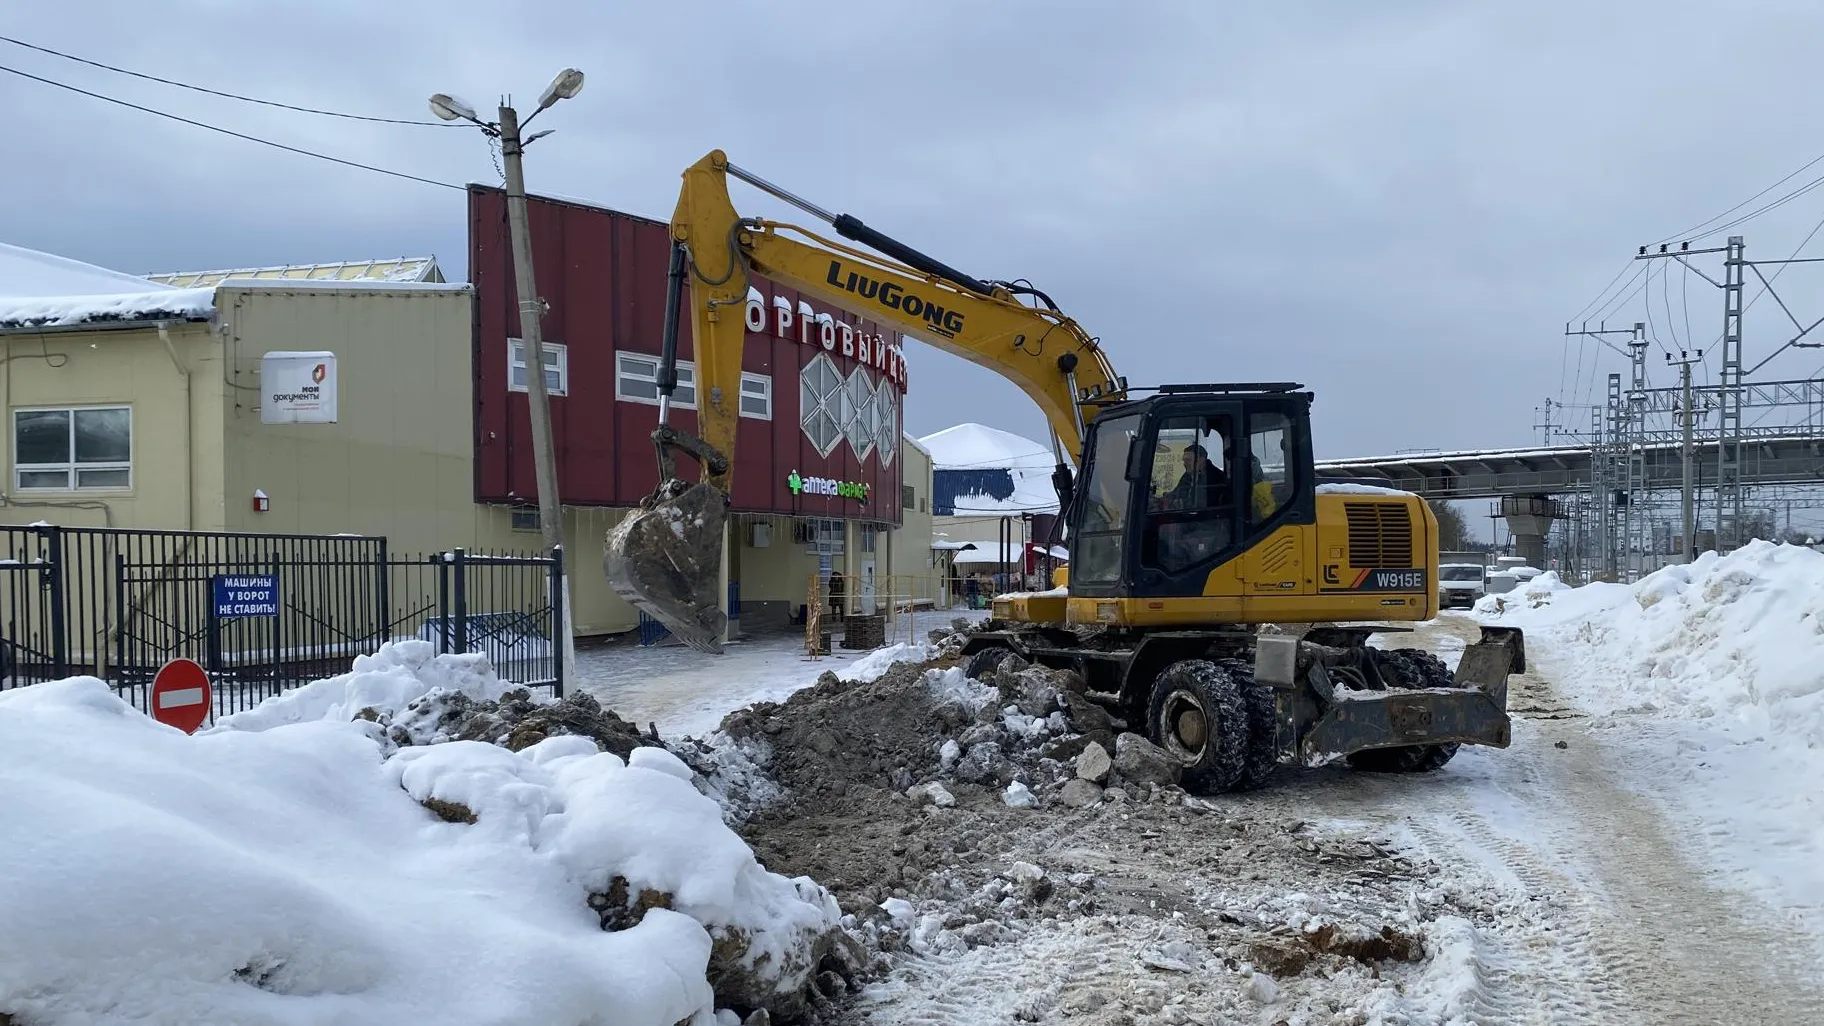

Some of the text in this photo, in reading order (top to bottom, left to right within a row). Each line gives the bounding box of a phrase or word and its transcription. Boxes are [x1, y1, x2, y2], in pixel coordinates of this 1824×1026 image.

[744, 300, 886, 371] ОРГОВЫЙ
[224, 578, 271, 588] МАШИНЫ
[1377, 573, 1421, 587] W915E
[228, 591, 270, 601] У ВОРОТ
[219, 604, 275, 614] НЕ СТАВИТЬ!
